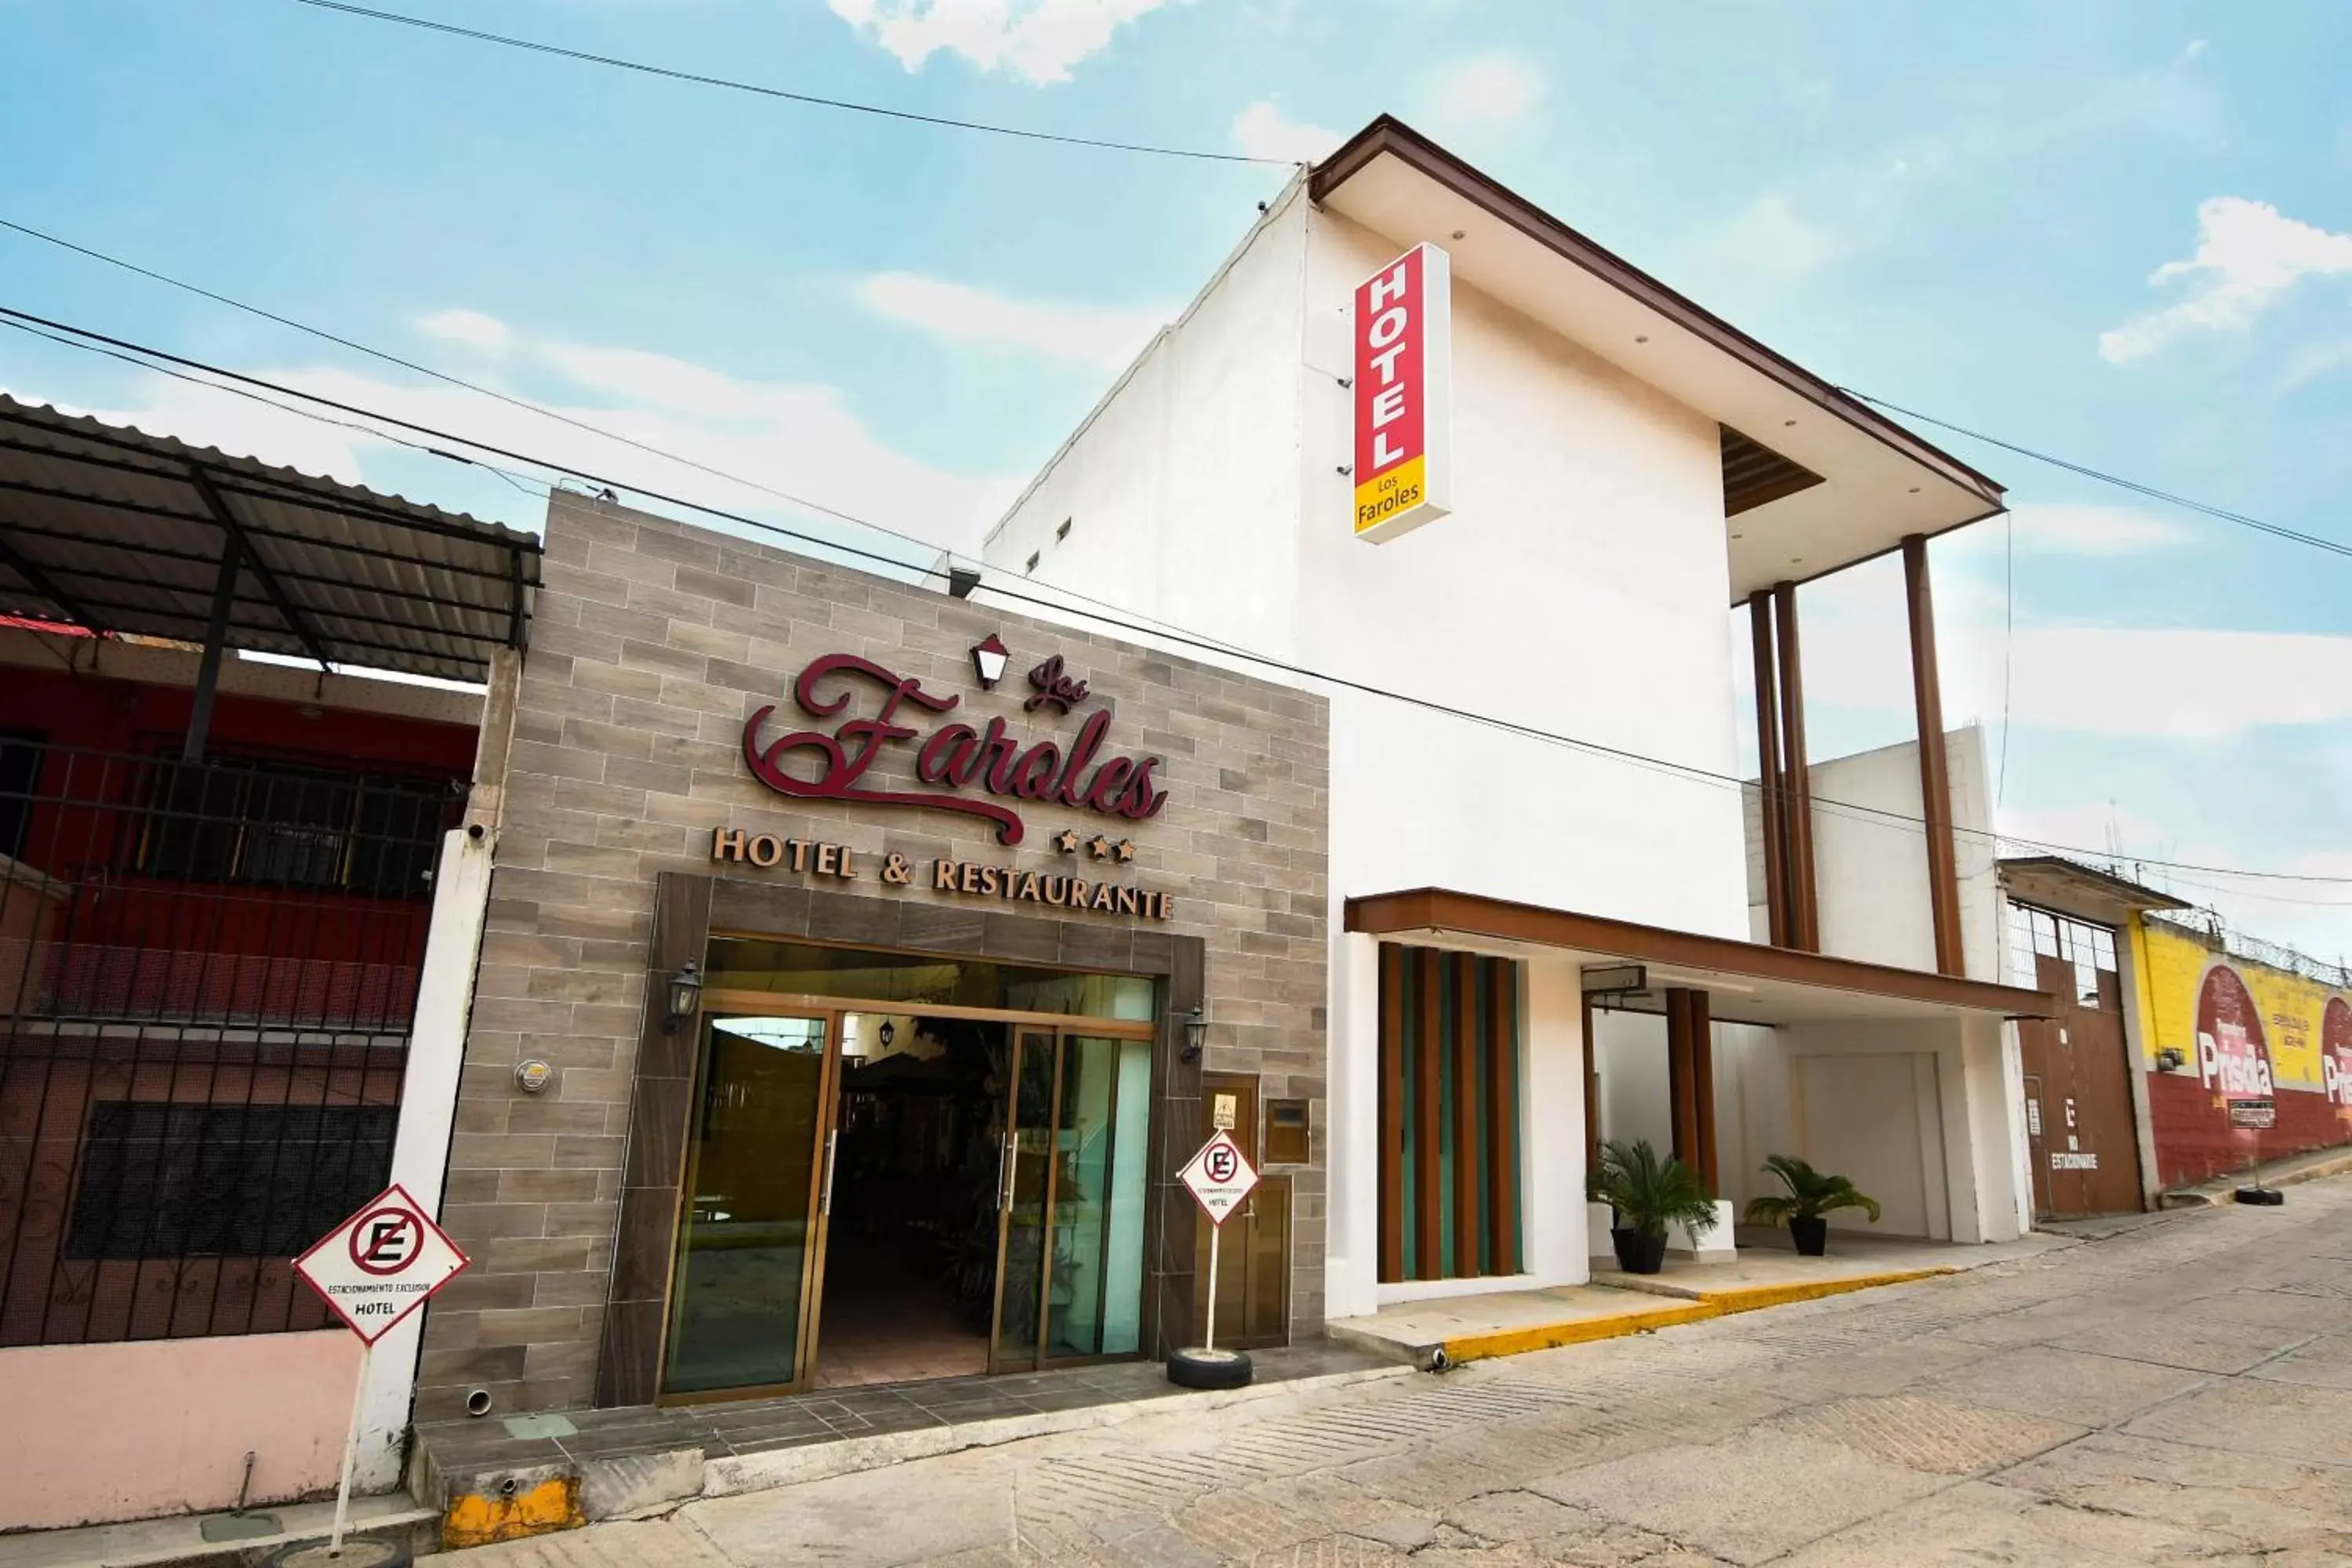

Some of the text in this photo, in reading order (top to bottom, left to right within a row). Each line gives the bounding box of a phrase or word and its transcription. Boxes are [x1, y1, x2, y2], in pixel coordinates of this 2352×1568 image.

[1369, 263, 1407, 470] HOTEL
[1358, 481, 1419, 524] Faroles
[1378, 474, 1398, 493] Los
[1024, 654, 1091, 715] Los
[742, 653, 1169, 845] Faroles
[710, 826, 1174, 921] HOTEL & RESTAURANTE
[1209, 1198, 1229, 1207] HOTEL
[368, 1223, 407, 1261] E
[328, 1283, 393, 1294] ESTACIONAMIENTO
[355, 1302, 395, 1315] HOTEL
